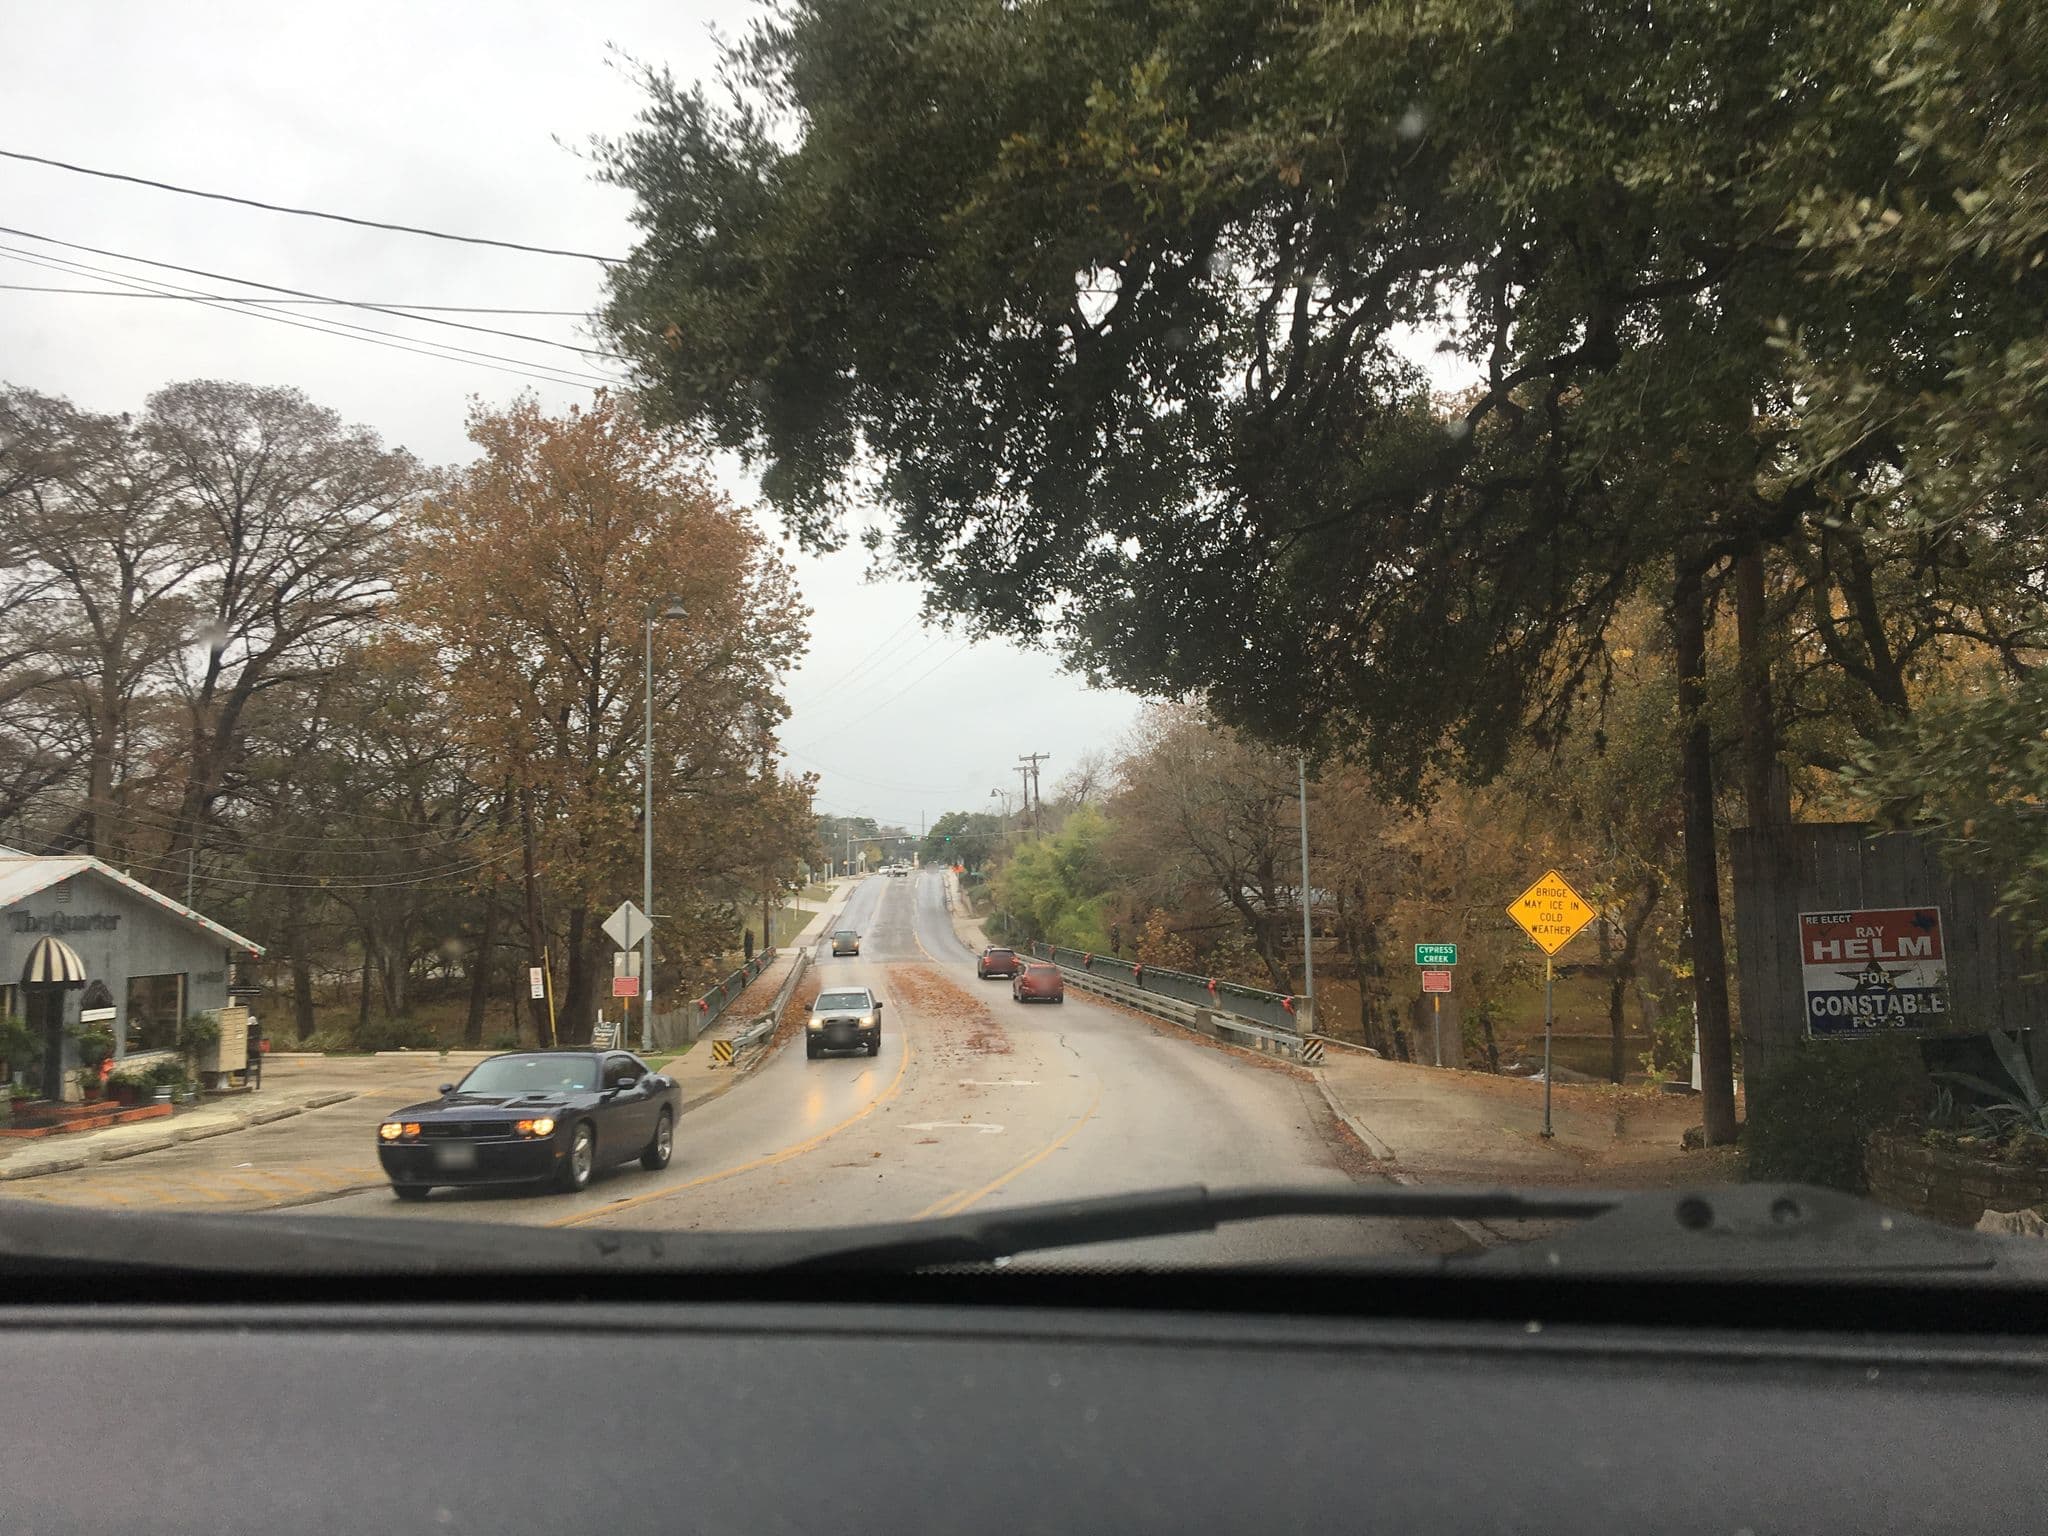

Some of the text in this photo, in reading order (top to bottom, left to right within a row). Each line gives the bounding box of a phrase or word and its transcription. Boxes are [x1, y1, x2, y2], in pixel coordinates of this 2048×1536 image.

[1536, 887, 1568, 898] BRIDGE
[1524, 900, 1579, 911] MAY ICE IN
[7, 910, 121, 933] The Quarter
[1540, 913, 1563, 922] COLD
[1806, 914, 1851, 924] RE ELECT
[1531, 925, 1571, 935] WEATHER
[1856, 926, 1884, 938] RAY
[1419, 946, 1454, 954] CYPRESS
[1812, 936, 1932, 960] HELM
[1424, 955, 1449, 963] CREEK
[1858, 973, 1890, 985] FOR
[1811, 994, 1945, 1017] CONSTABLE
[1895, 1015, 1906, 1027] 3
